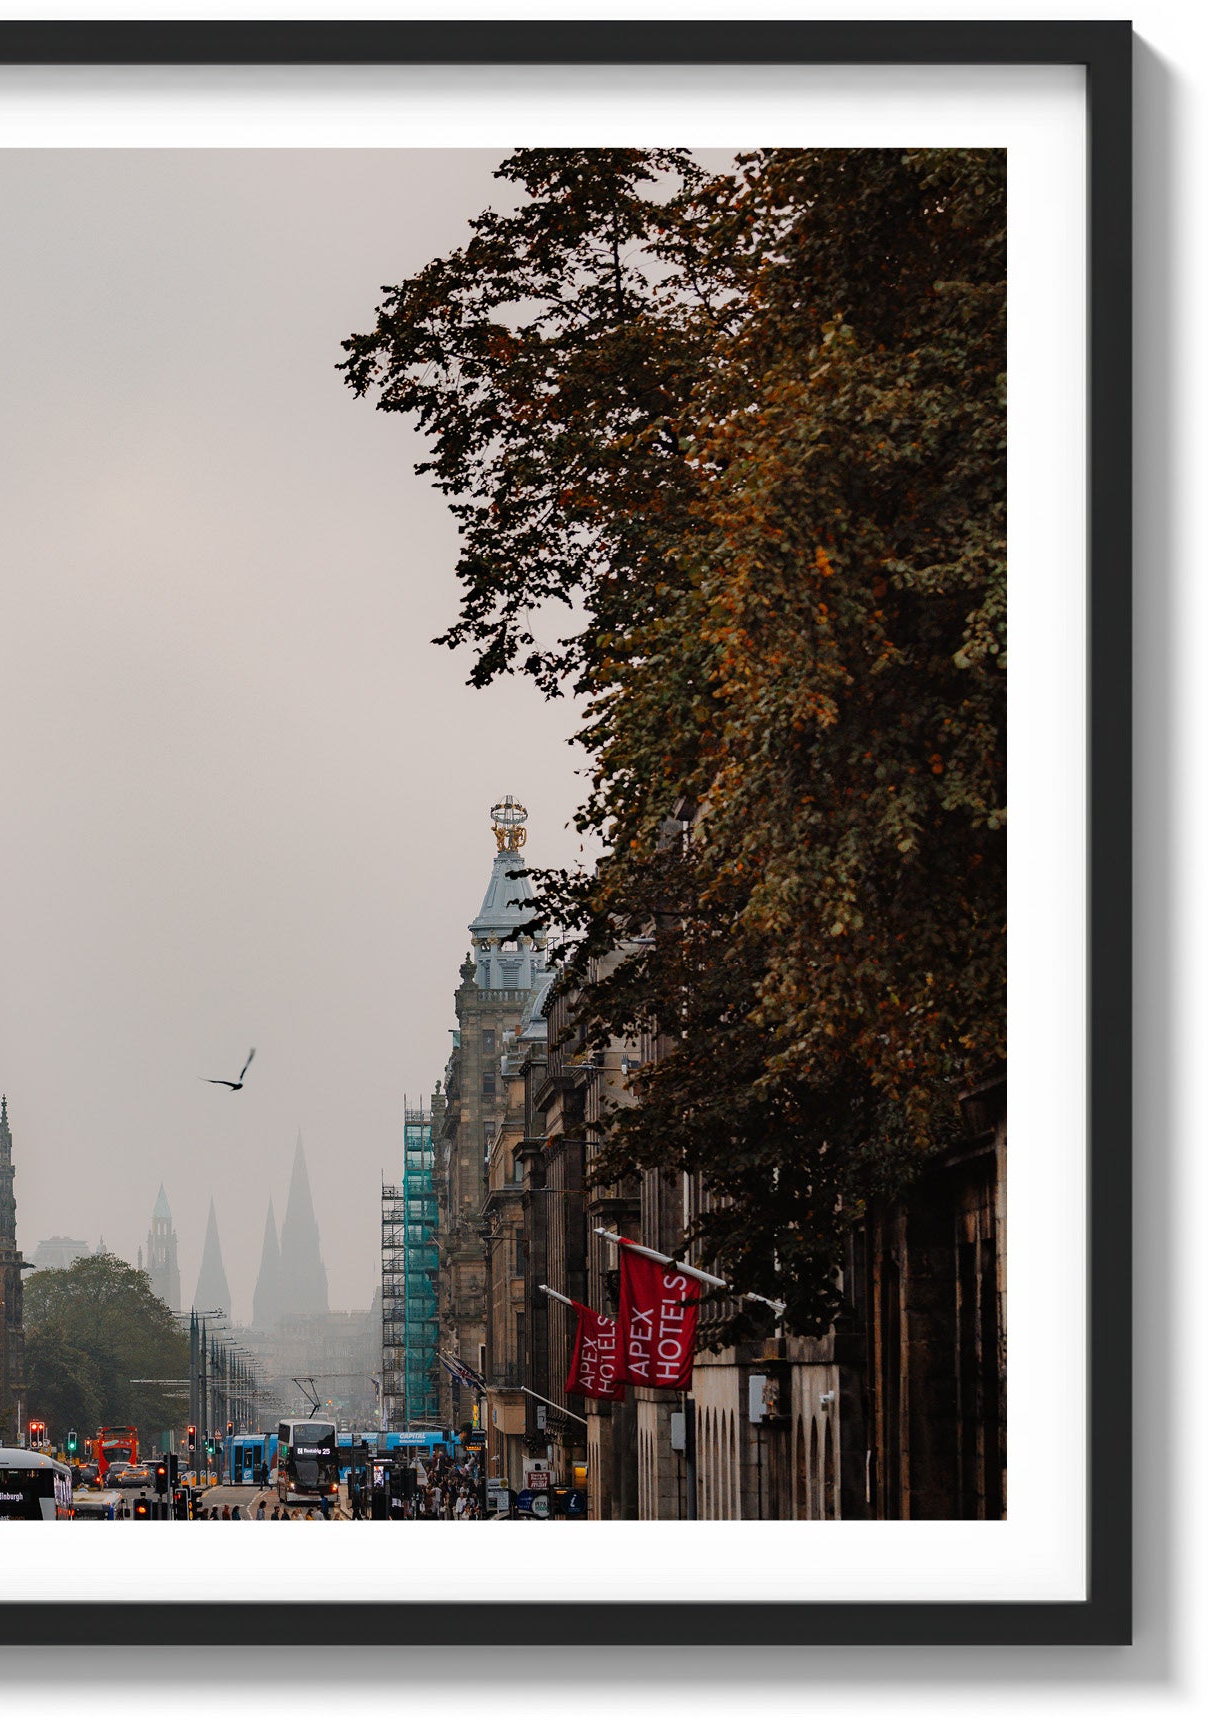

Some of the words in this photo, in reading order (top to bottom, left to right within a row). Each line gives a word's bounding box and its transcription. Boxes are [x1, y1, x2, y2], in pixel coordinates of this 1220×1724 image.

[579, 1336, 598, 1390] APEX
[628, 1306, 654, 1378] APEX
[656, 1275, 687, 1379] HOTELS
